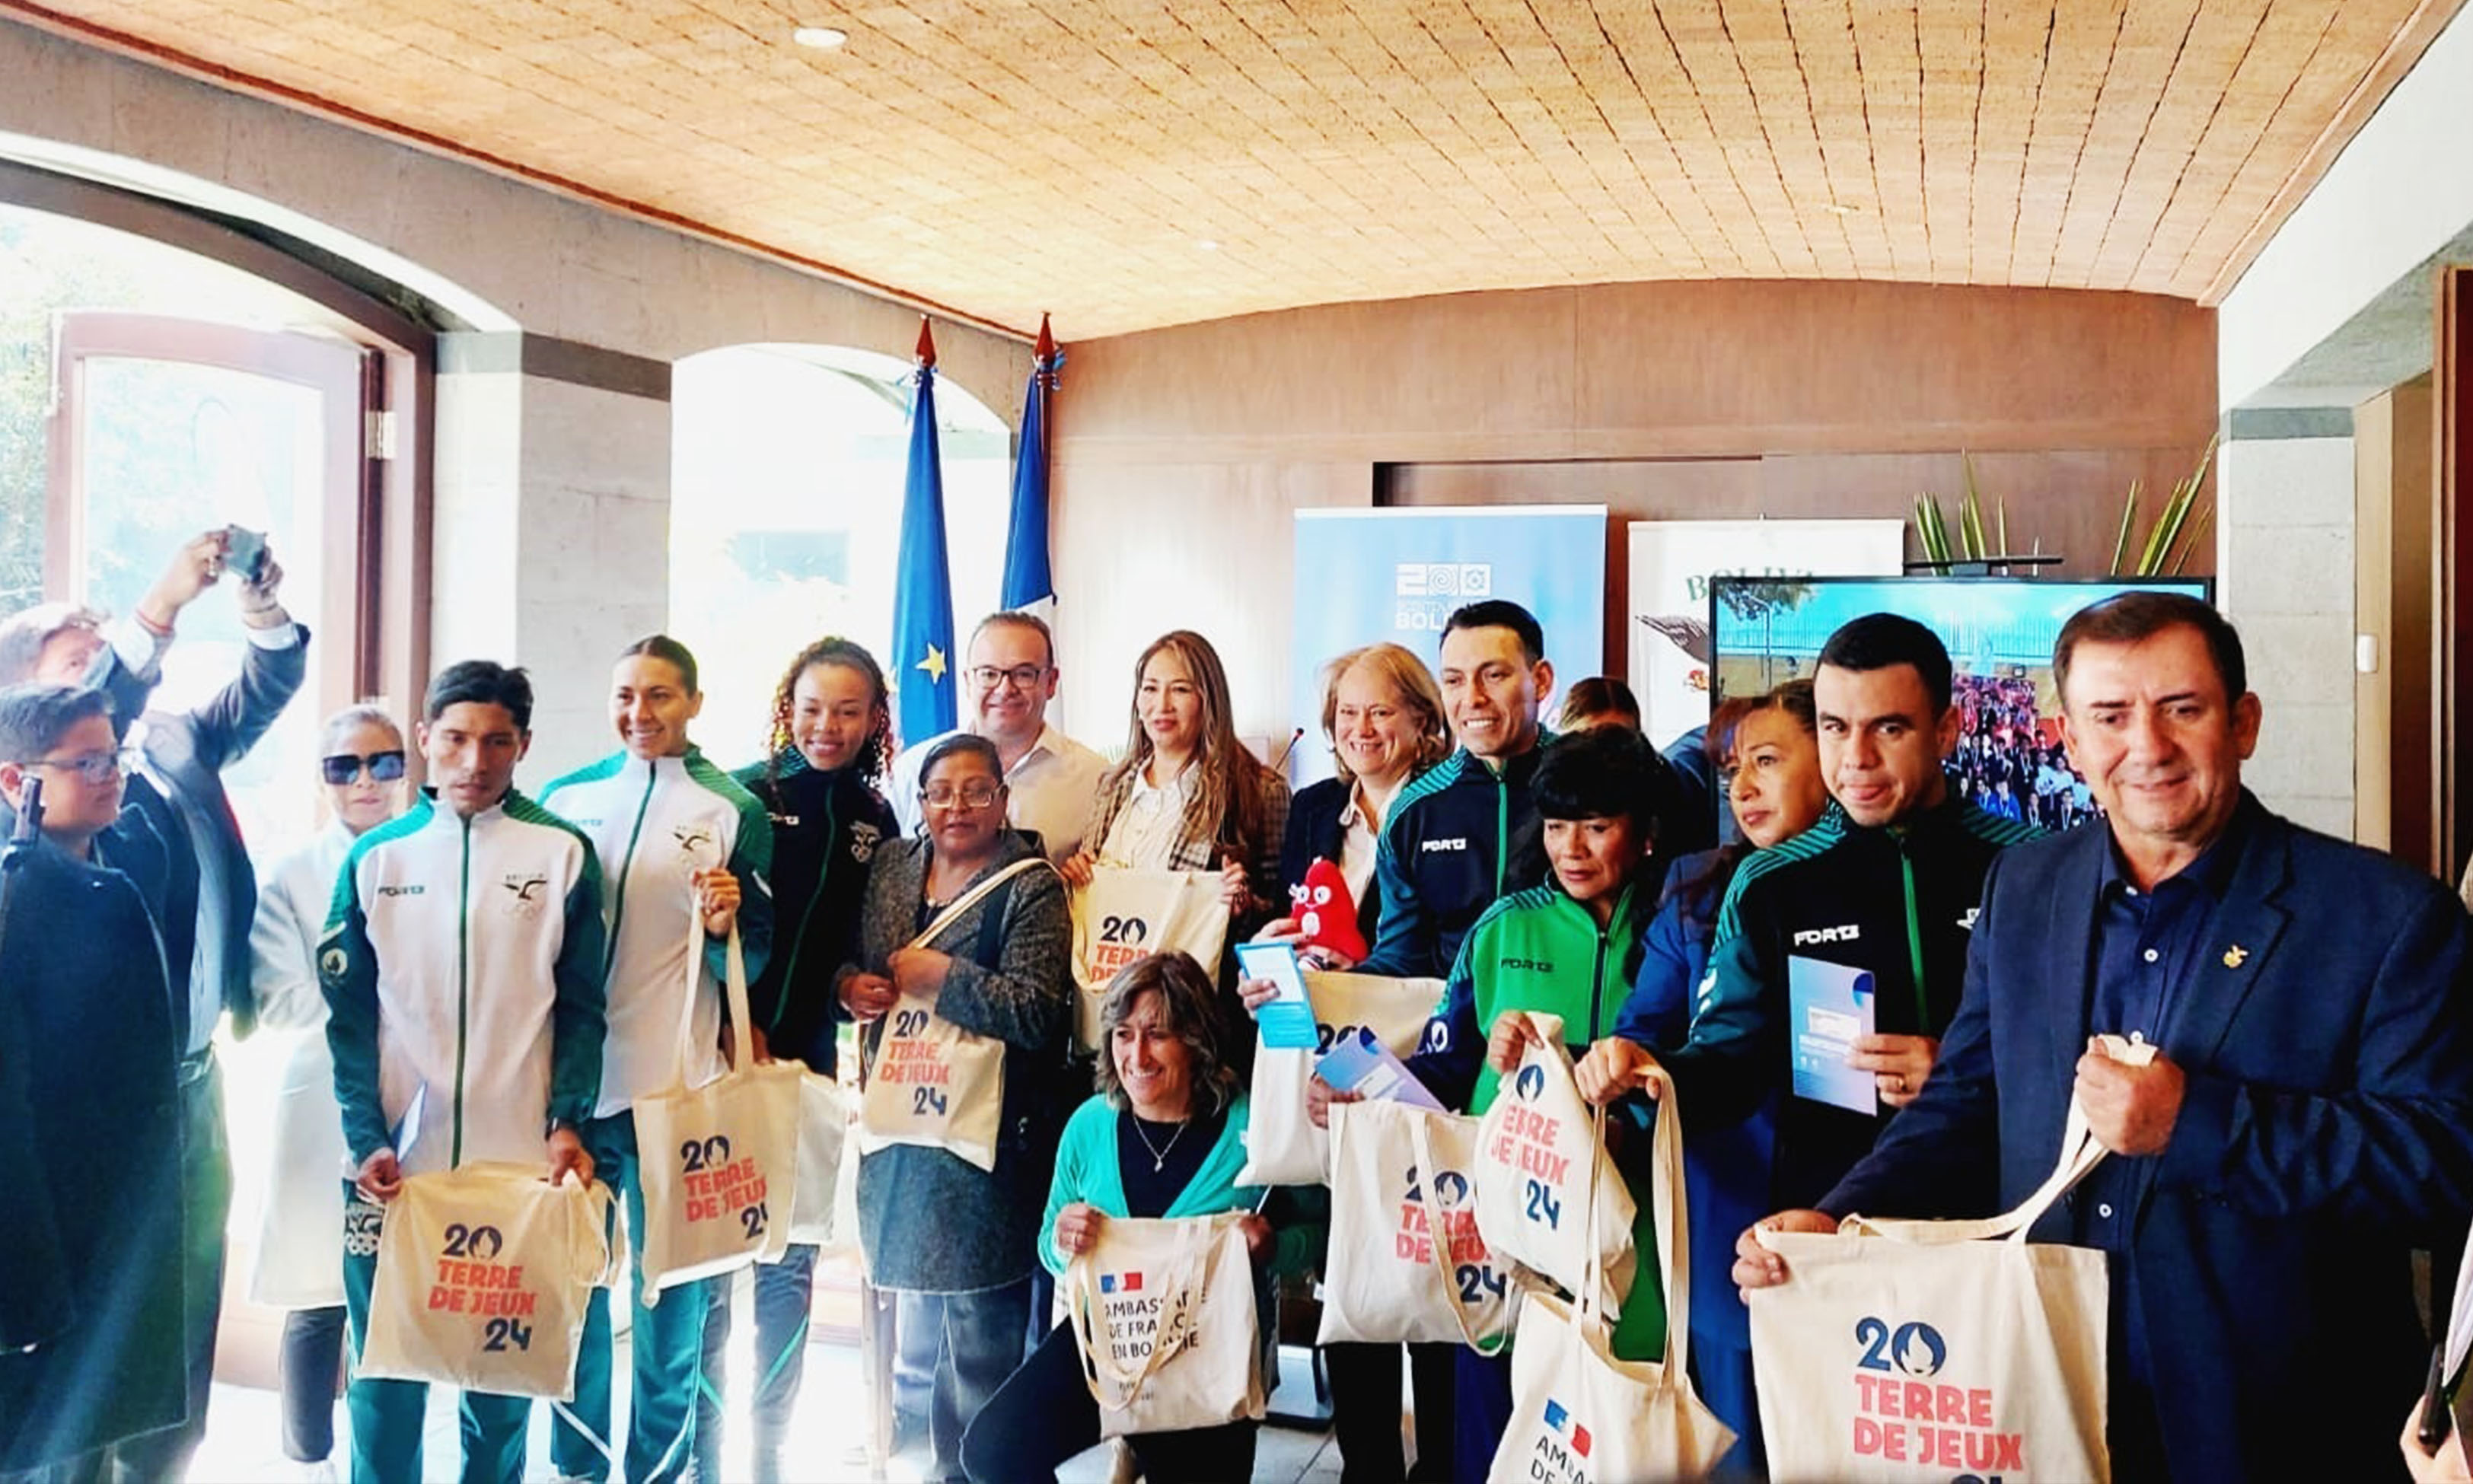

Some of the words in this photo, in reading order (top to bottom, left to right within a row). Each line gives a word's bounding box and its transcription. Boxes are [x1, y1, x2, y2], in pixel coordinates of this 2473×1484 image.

[1395, 611, 1449, 630] BOLI
[1101, 916, 1147, 944] 20
[894, 1010, 929, 1037] 20
[889, 1040, 939, 1060] TERRE
[881, 1063, 904, 1084] DE
[914, 1086, 948, 1116] 24
[1503, 1104, 1560, 1146] ERRE
[680, 1135, 730, 1173] 20
[684, 1156, 756, 1197] TERRE
[687, 1197, 719, 1222] DE
[722, 1177, 766, 1215] JEU
[1526, 1178, 1560, 1231] 24
[441, 1223, 503, 1259] 20
[1396, 1233, 1432, 1265] DE
[438, 1259, 524, 1289] TERRE
[1455, 1264, 1507, 1302] 24
[428, 1286, 467, 1312] DE
[469, 1291, 537, 1317] JEUX
[483, 1317, 532, 1352] 24
[1856, 1316, 1947, 1377] 20
[1855, 1374, 1993, 1428] TERRE
[1854, 1417, 1907, 1461] DE
[1917, 1427, 2022, 1471] JEUX
